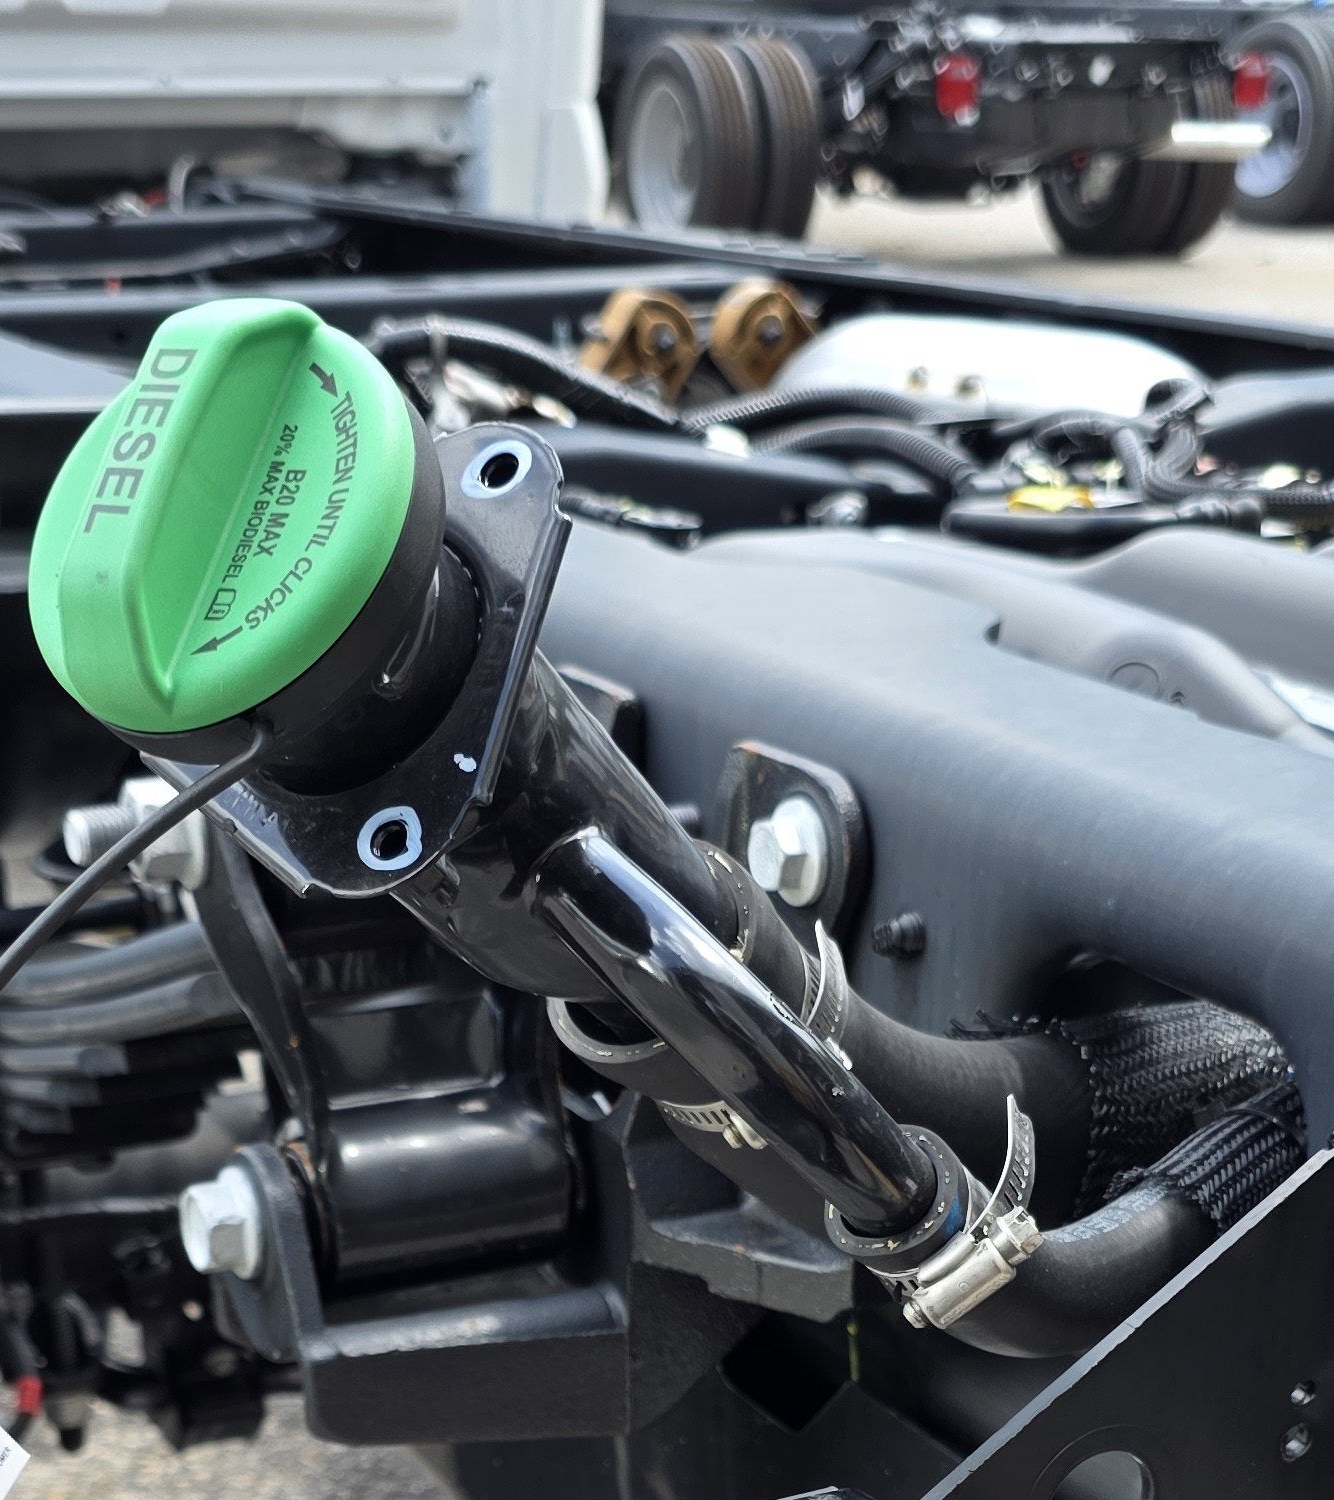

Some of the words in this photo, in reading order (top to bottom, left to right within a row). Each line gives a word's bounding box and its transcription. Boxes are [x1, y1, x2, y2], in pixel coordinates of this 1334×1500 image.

[83, 347, 198, 535] DIESEL
[273, 423, 299, 457] 20%
[330, 390, 358, 486] TIGHTEN
[258, 460, 286, 496] MAX
[275, 469, 307, 506] B20
[222, 500, 270, 584] BIODIESEL
[253, 512, 290, 557] MAX
[304, 487, 350, 552] UNTIL
[244, 556, 313, 631] CLICKS
